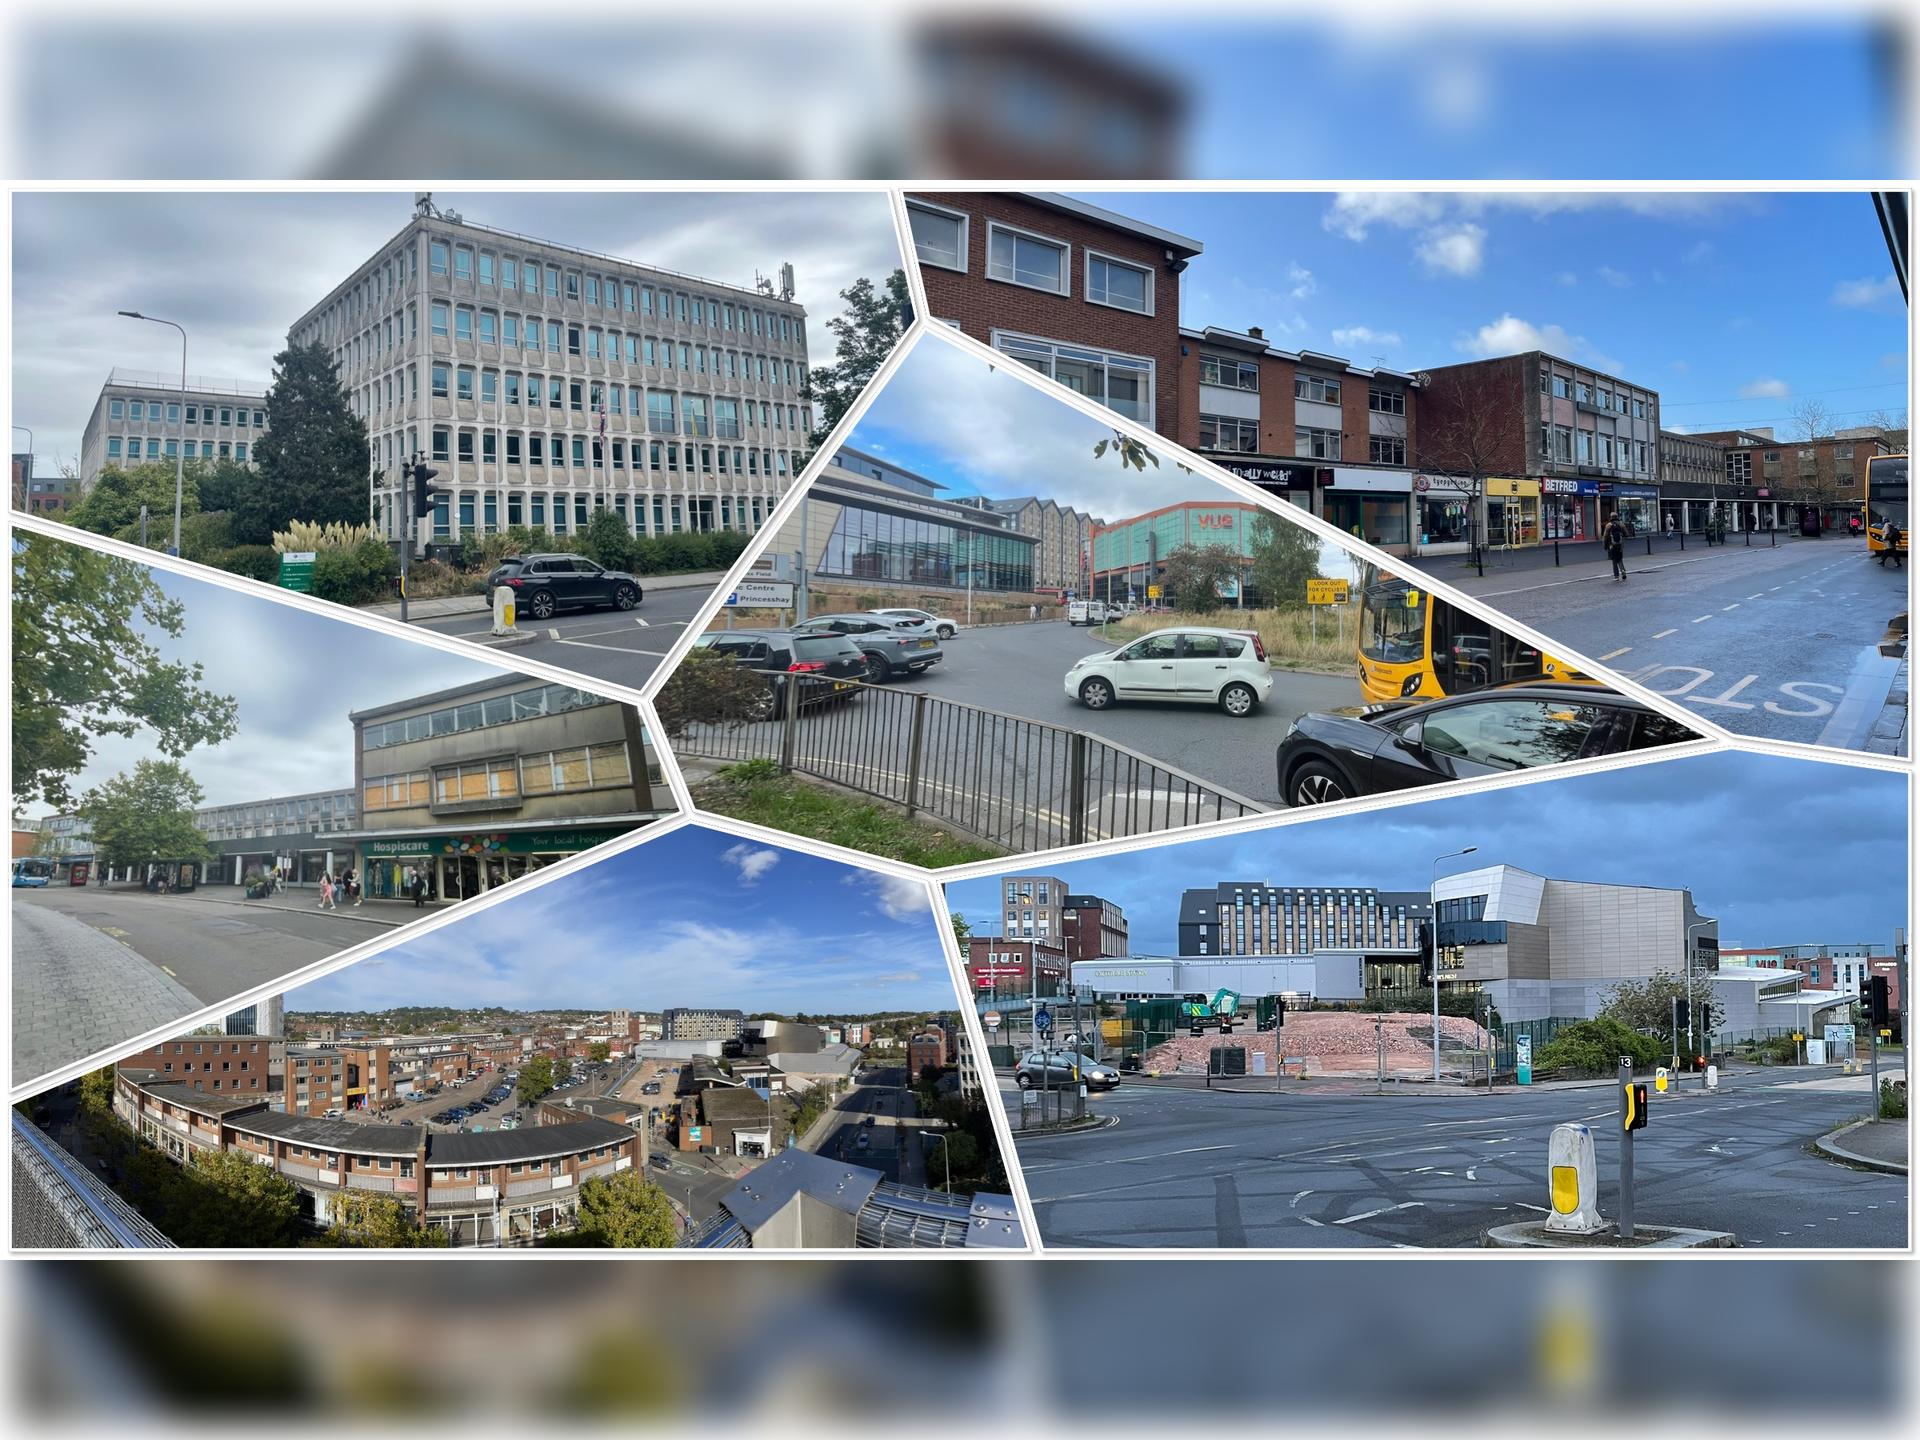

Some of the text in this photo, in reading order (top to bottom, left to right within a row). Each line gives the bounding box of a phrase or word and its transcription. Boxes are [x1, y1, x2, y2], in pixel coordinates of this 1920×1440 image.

[1545, 480, 1578, 493] BETFRED
[740, 595, 791, 604] Princesshay
[373, 841, 430, 854] Hospiscare
[1620, 1057, 1631, 1068] 13
